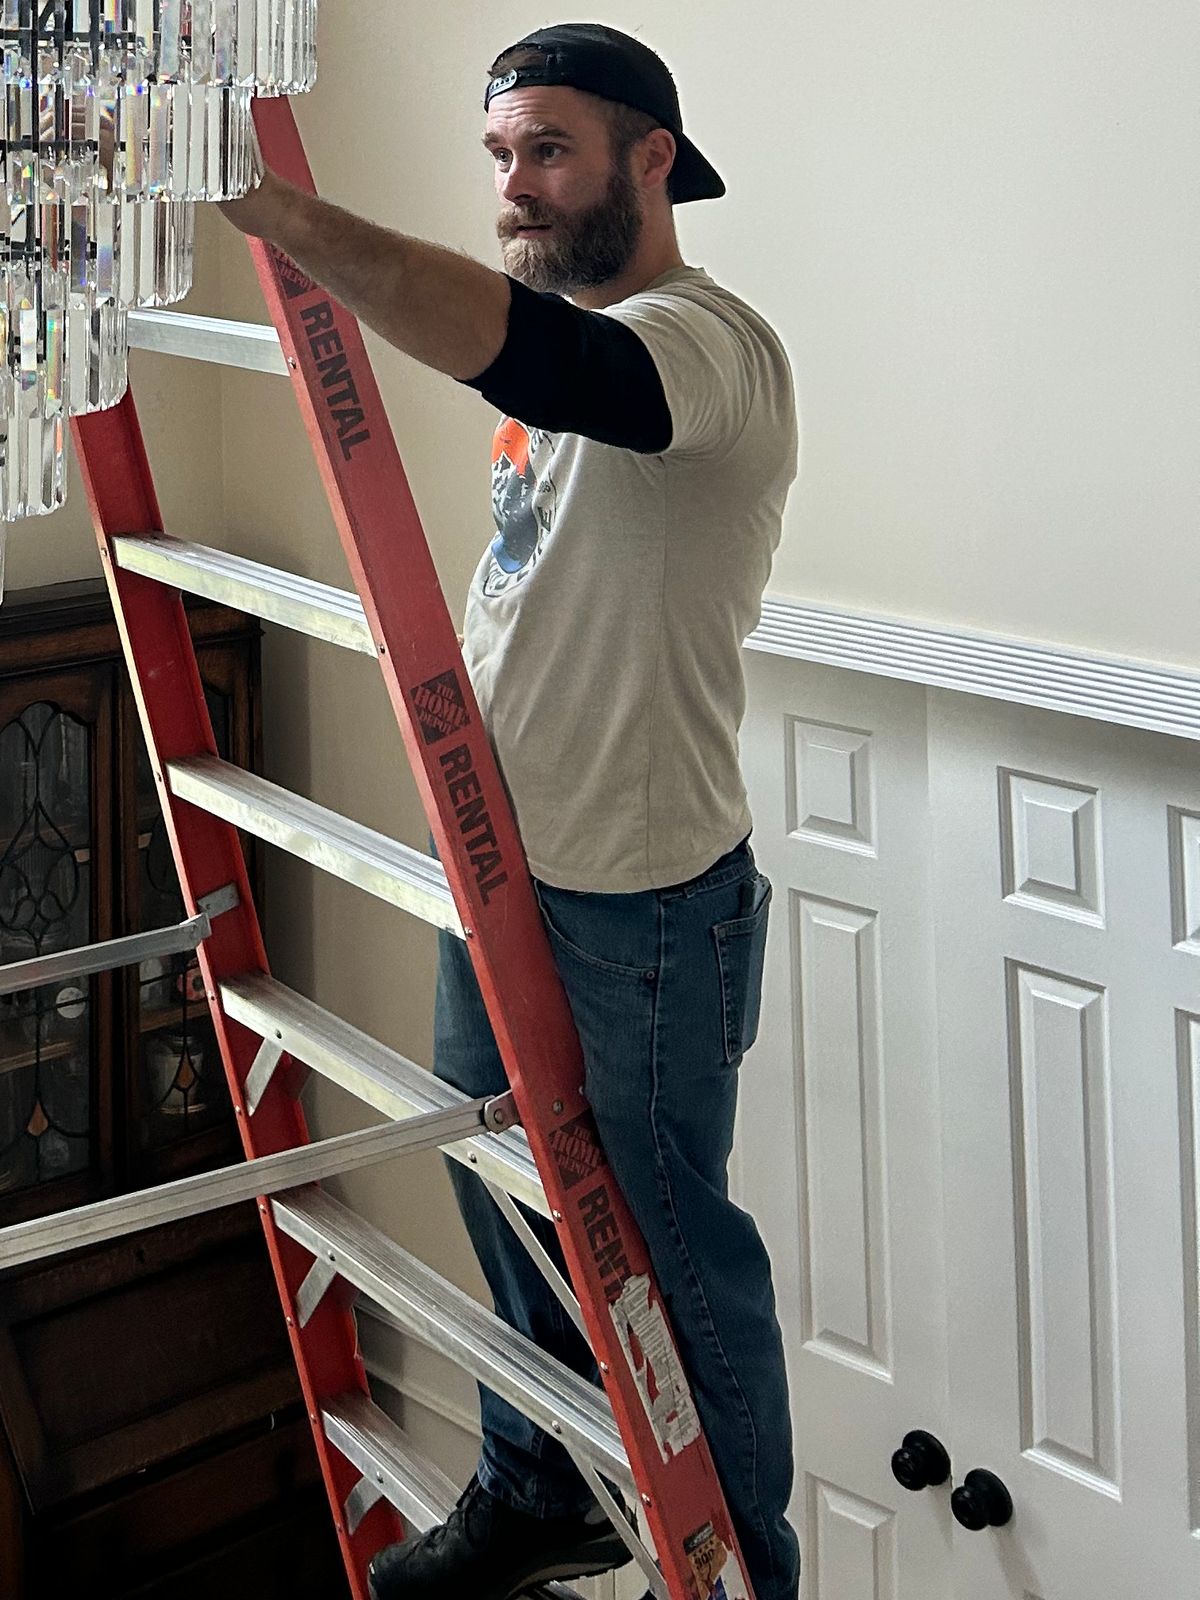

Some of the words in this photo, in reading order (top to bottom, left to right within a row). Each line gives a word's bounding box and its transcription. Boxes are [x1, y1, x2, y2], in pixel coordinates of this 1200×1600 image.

[300, 300, 371, 462] RENTAL
[414, 686, 466, 727] HOME
[439, 743, 509, 907] RENTAL
[551, 1130, 601, 1169] HOME
[577, 1184, 634, 1306] RENT
